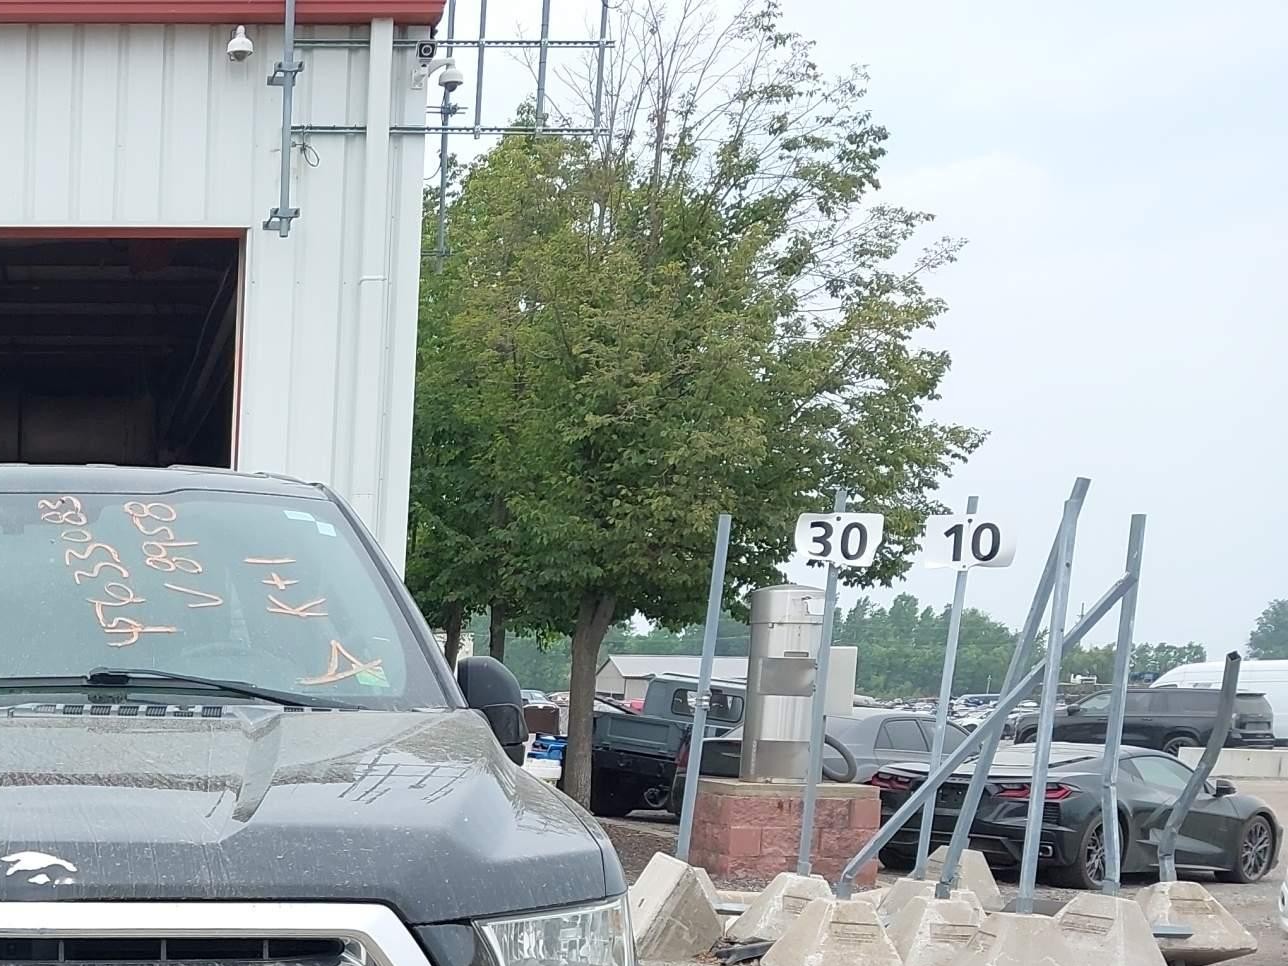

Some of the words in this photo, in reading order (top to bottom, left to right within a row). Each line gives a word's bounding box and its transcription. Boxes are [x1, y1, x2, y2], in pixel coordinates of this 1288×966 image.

[808, 521, 868, 561] 30
[943, 522, 1001, 562] 10
[38, 495, 178, 648] 45633083
